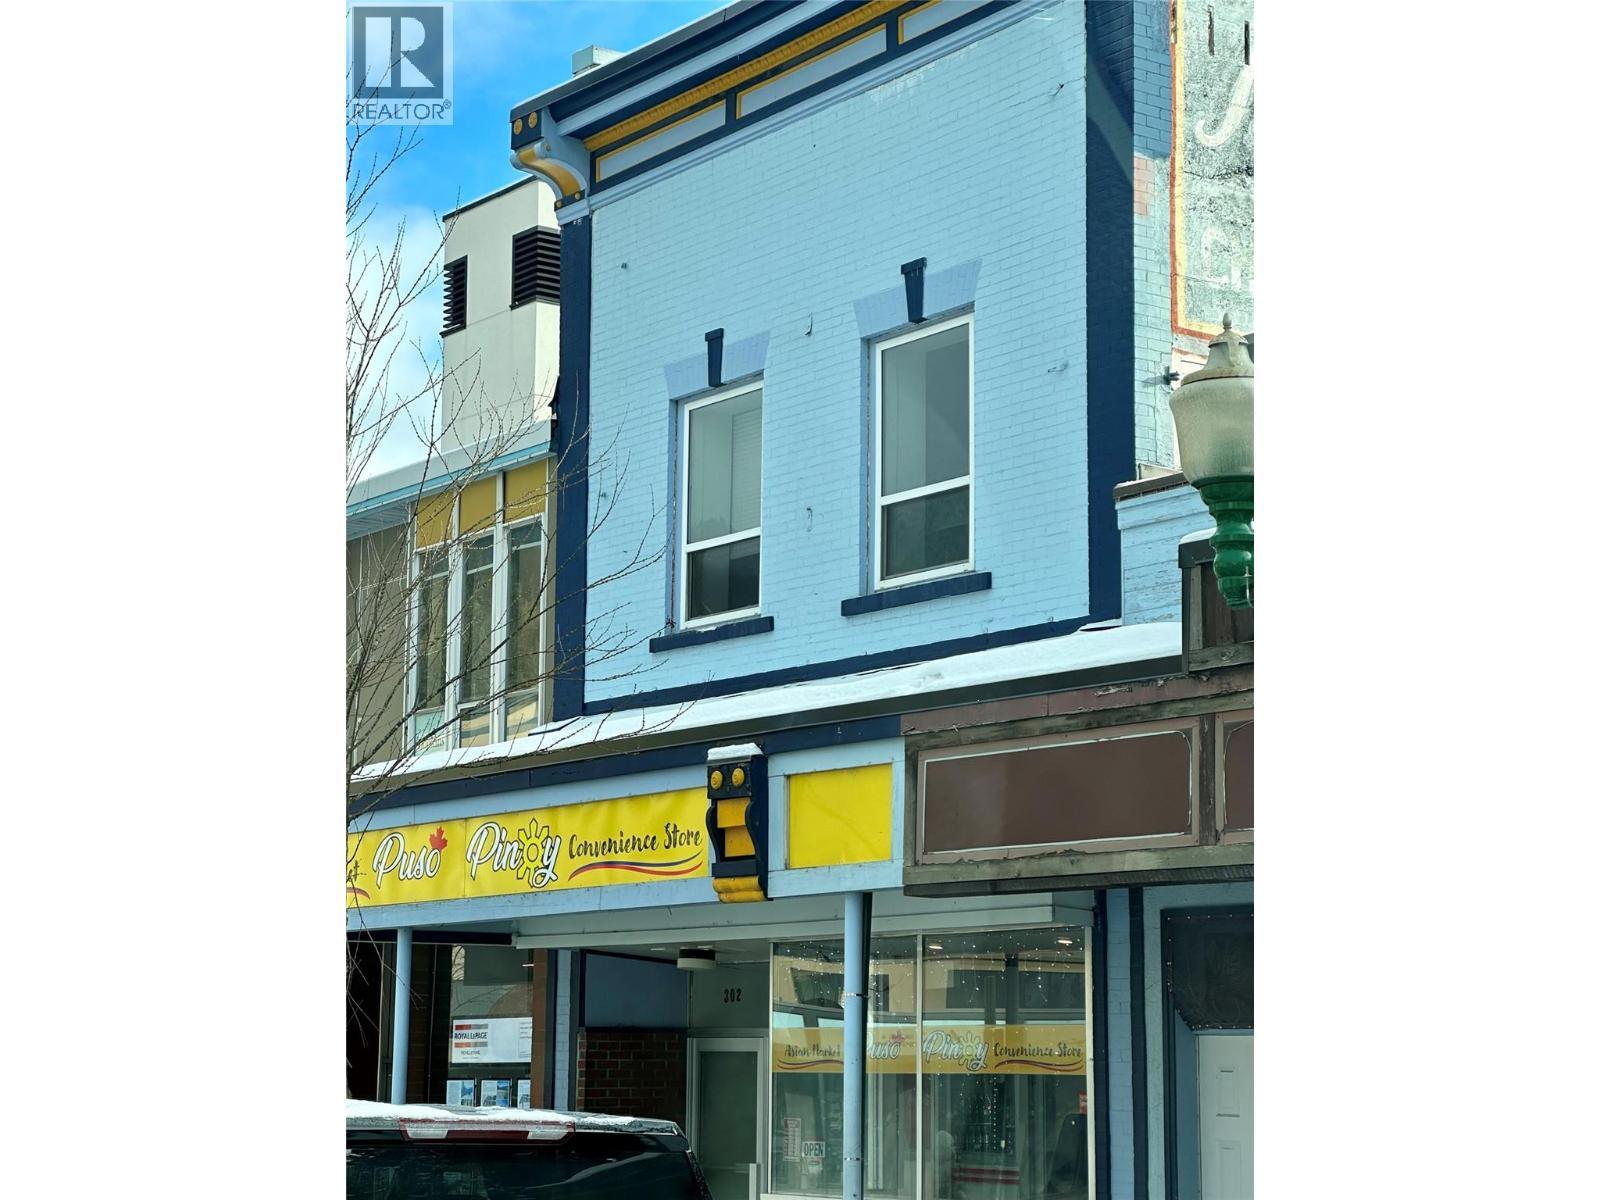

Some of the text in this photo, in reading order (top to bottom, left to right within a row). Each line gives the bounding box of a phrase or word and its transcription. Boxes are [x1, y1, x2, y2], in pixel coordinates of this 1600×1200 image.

[372, 832, 443, 889] Puso
[465, 817, 562, 889] Pinoy
[568, 829, 660, 860] Convenience
[663, 821, 703, 850] Store
[723, 988, 742, 1004] 302
[922, 1029, 989, 1071] Pinoy
[993, 1042, 1053, 1057] Convenience
[1056, 1042, 1082, 1057] Store
[803, 1142, 824, 1156] OPEN
